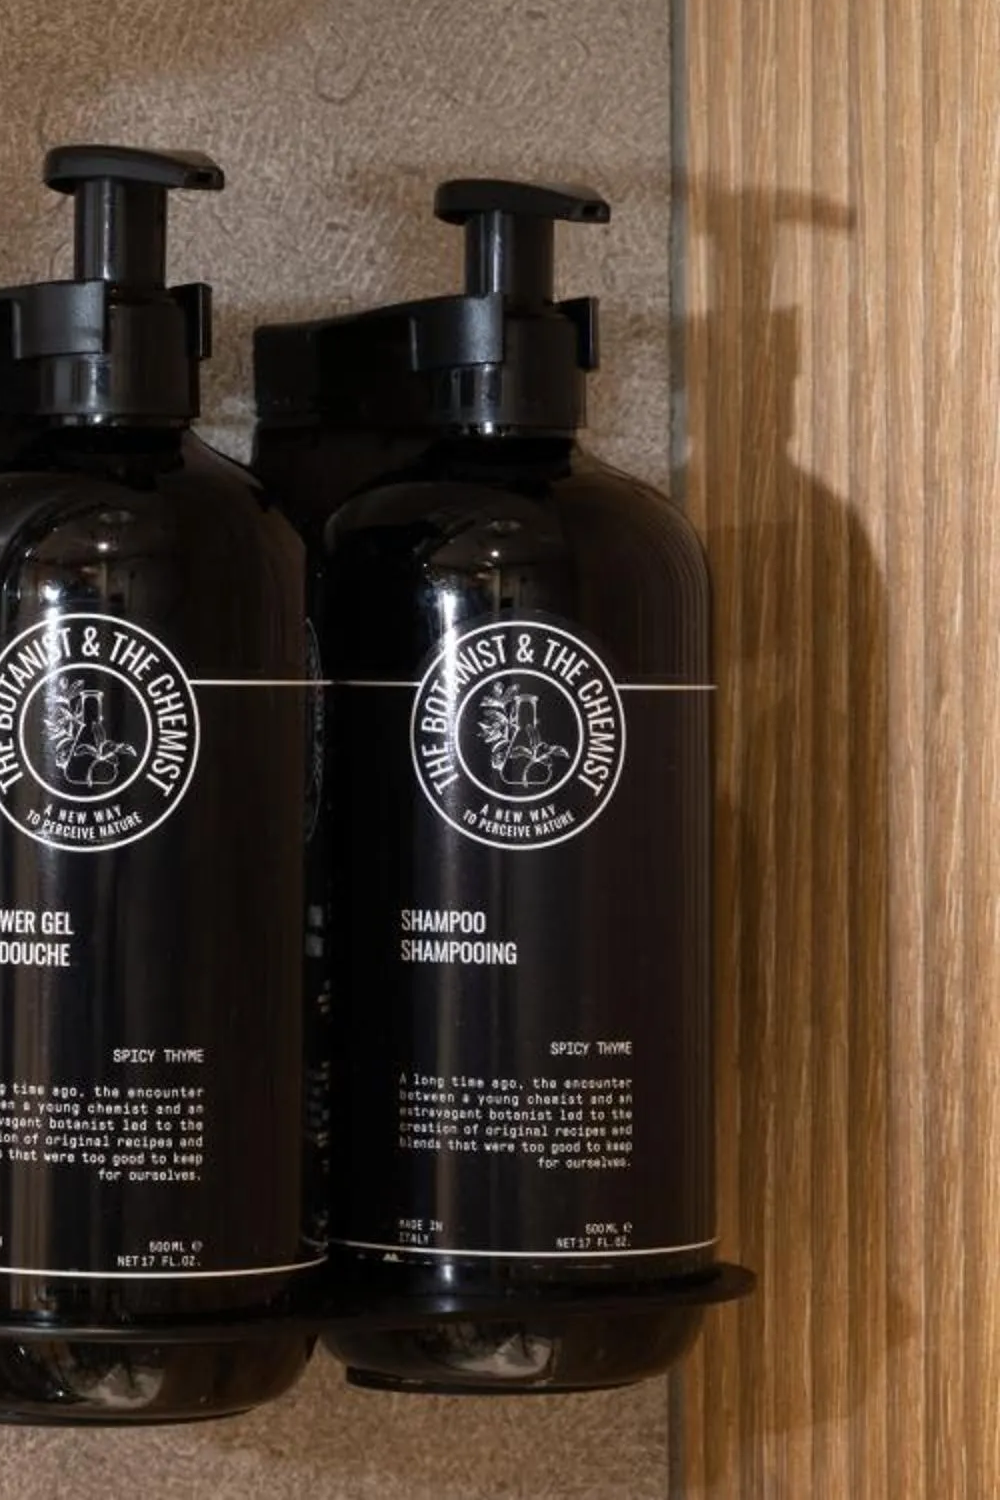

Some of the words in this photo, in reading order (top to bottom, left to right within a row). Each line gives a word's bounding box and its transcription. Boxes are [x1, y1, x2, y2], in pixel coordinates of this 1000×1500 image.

[82, 626, 100, 657] &
[110, 632, 159, 681] THE
[147, 674, 188, 796] CHEMIST
[421, 744, 459, 796] THE
[516, 634, 534, 662] &
[543, 639, 589, 685] THE
[578, 679, 614, 796] CHEMIST
[44, 804, 52, 816] A
[58, 808, 87, 824] NEW
[94, 804, 121, 822] WAY
[480, 804, 489, 816] A
[496, 808, 523, 822] NEW
[530, 804, 555, 822] WAY
[26, 809, 40, 825] TO
[42, 819, 95, 839] PERCEIVE
[100, 811, 142, 836] NATURE
[463, 809, 477, 825] TO
[478, 818, 531, 837] PERCEIVE
[534, 810, 576, 836] NATURE
[41, 912, 74, 936] GEL
[401, 910, 486, 934] SHAMPOO
[401, 939, 517, 964] SHAMPOOING
[113, 1049, 154, 1064] SPICY
[164, 1049, 204, 1063] THYME
[550, 1041, 590, 1056] SPICY
[596, 1042, 632, 1056] THYME
[400, 1072, 406, 1084] A
[414, 1073, 444, 1088] long
[452, 1076, 484, 1088] time
[533, 1078, 556, 1088] the
[564, 1078, 632, 1089] encounter
[13, 1082, 44, 1095] time
[94, 1086, 119, 1098] the
[128, 1087, 204, 1098] encounter
[478, 1095, 518, 1106] young
[528, 1093, 583, 1104] chemist
[592, 1094, 613, 1104] and
[620, 1095, 632, 1104] an
[23, 1101, 30, 1111] a
[38, 1103, 80, 1116] young
[88, 1102, 148, 1114] chemist
[156, 1102, 180, 1114] and
[188, 1104, 204, 1114] an
[489, 1108, 552, 1120] botanist
[561, 1108, 582, 1120] led
[590, 1110, 605, 1120] to
[612, 1109, 632, 1120] the
[49, 1117, 114, 1130] botanist
[123, 1119, 146, 1130] led
[156, 1120, 172, 1130] to
[180, 1120, 203, 1131] the
[464, 1124, 478, 1135] of
[485, 1124, 548, 1139] original
[556, 1125, 606, 1138] recipes
[23, 1134, 38, 1144] of
[45, 1134, 109, 1148] original
[117, 1136, 172, 1150] recipes
[180, 1136, 202, 1148] and
[448, 1140, 477, 1151] that
[484, 1143, 515, 1152] were
[522, 1141, 544, 1152] too
[551, 1141, 580, 1155] good
[587, 1141, 600, 1152] to
[9, 1148, 38, 1160] that
[44, 1154, 75, 1162] were
[82, 1152, 106, 1164] too
[112, 1152, 144, 1166] good
[152, 1153, 166, 1164] to
[174, 1152, 202, 1166] keep
[537, 1156, 560, 1168] for
[98, 1168, 121, 1180] for
[129, 1168, 200, 1180] ourselves.
[430, 1220, 443, 1232] IN
